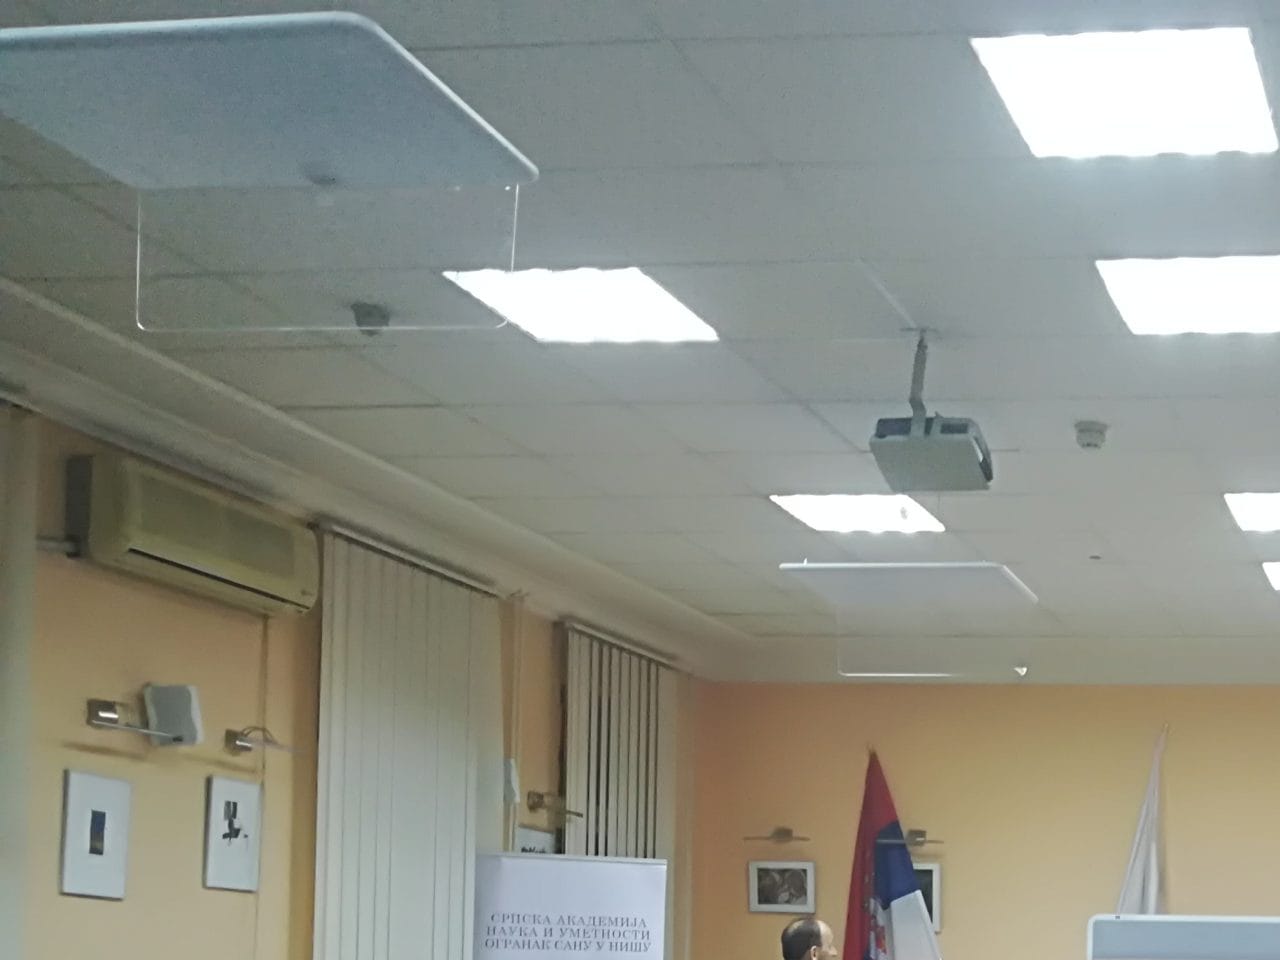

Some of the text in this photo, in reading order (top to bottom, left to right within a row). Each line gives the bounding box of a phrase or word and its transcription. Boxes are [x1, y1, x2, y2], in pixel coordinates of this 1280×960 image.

[490, 913, 647, 928] СРПСКА АКАДЕМИЈА
[486, 926, 650, 940] НАУКА И УМЕТНОСТИ
[484, 938, 652, 953] ОГРАНАК САНУ У НИШУ
